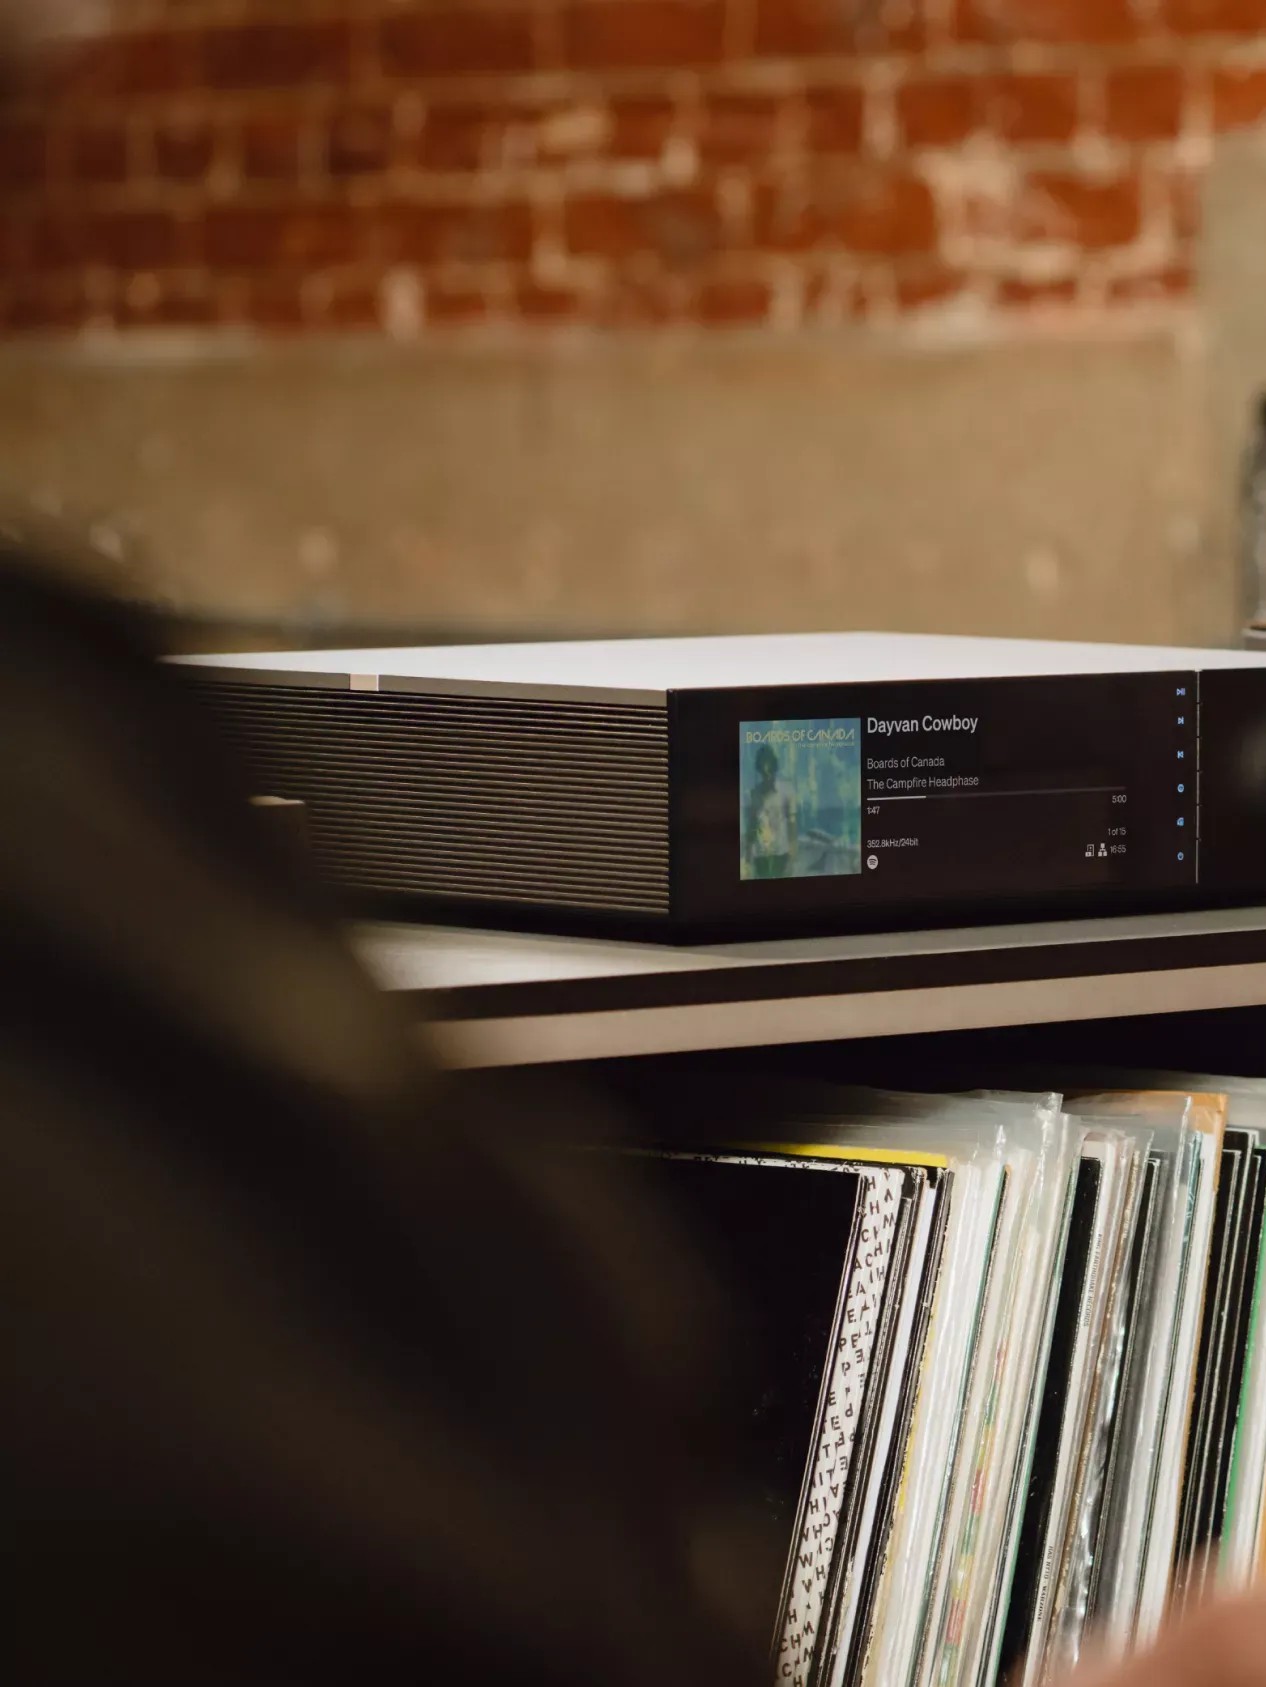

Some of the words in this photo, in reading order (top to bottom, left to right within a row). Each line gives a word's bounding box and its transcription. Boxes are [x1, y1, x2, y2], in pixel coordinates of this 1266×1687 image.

[867, 717, 919, 736] Dayvan
[922, 714, 978, 733] Cowboy
[792, 730, 805, 742] OF
[807, 728, 855, 741] CANADA
[867, 758, 899, 769] Boards
[900, 757, 910, 768] of
[911, 756, 945, 767] Canada
[867, 778, 885, 790] The
[886, 777, 927, 790] Campfire
[928, 775, 979, 788] Headphase
[1112, 794, 1127, 803] 5:00
[867, 838, 919, 848] 352.8kHz/24bit
